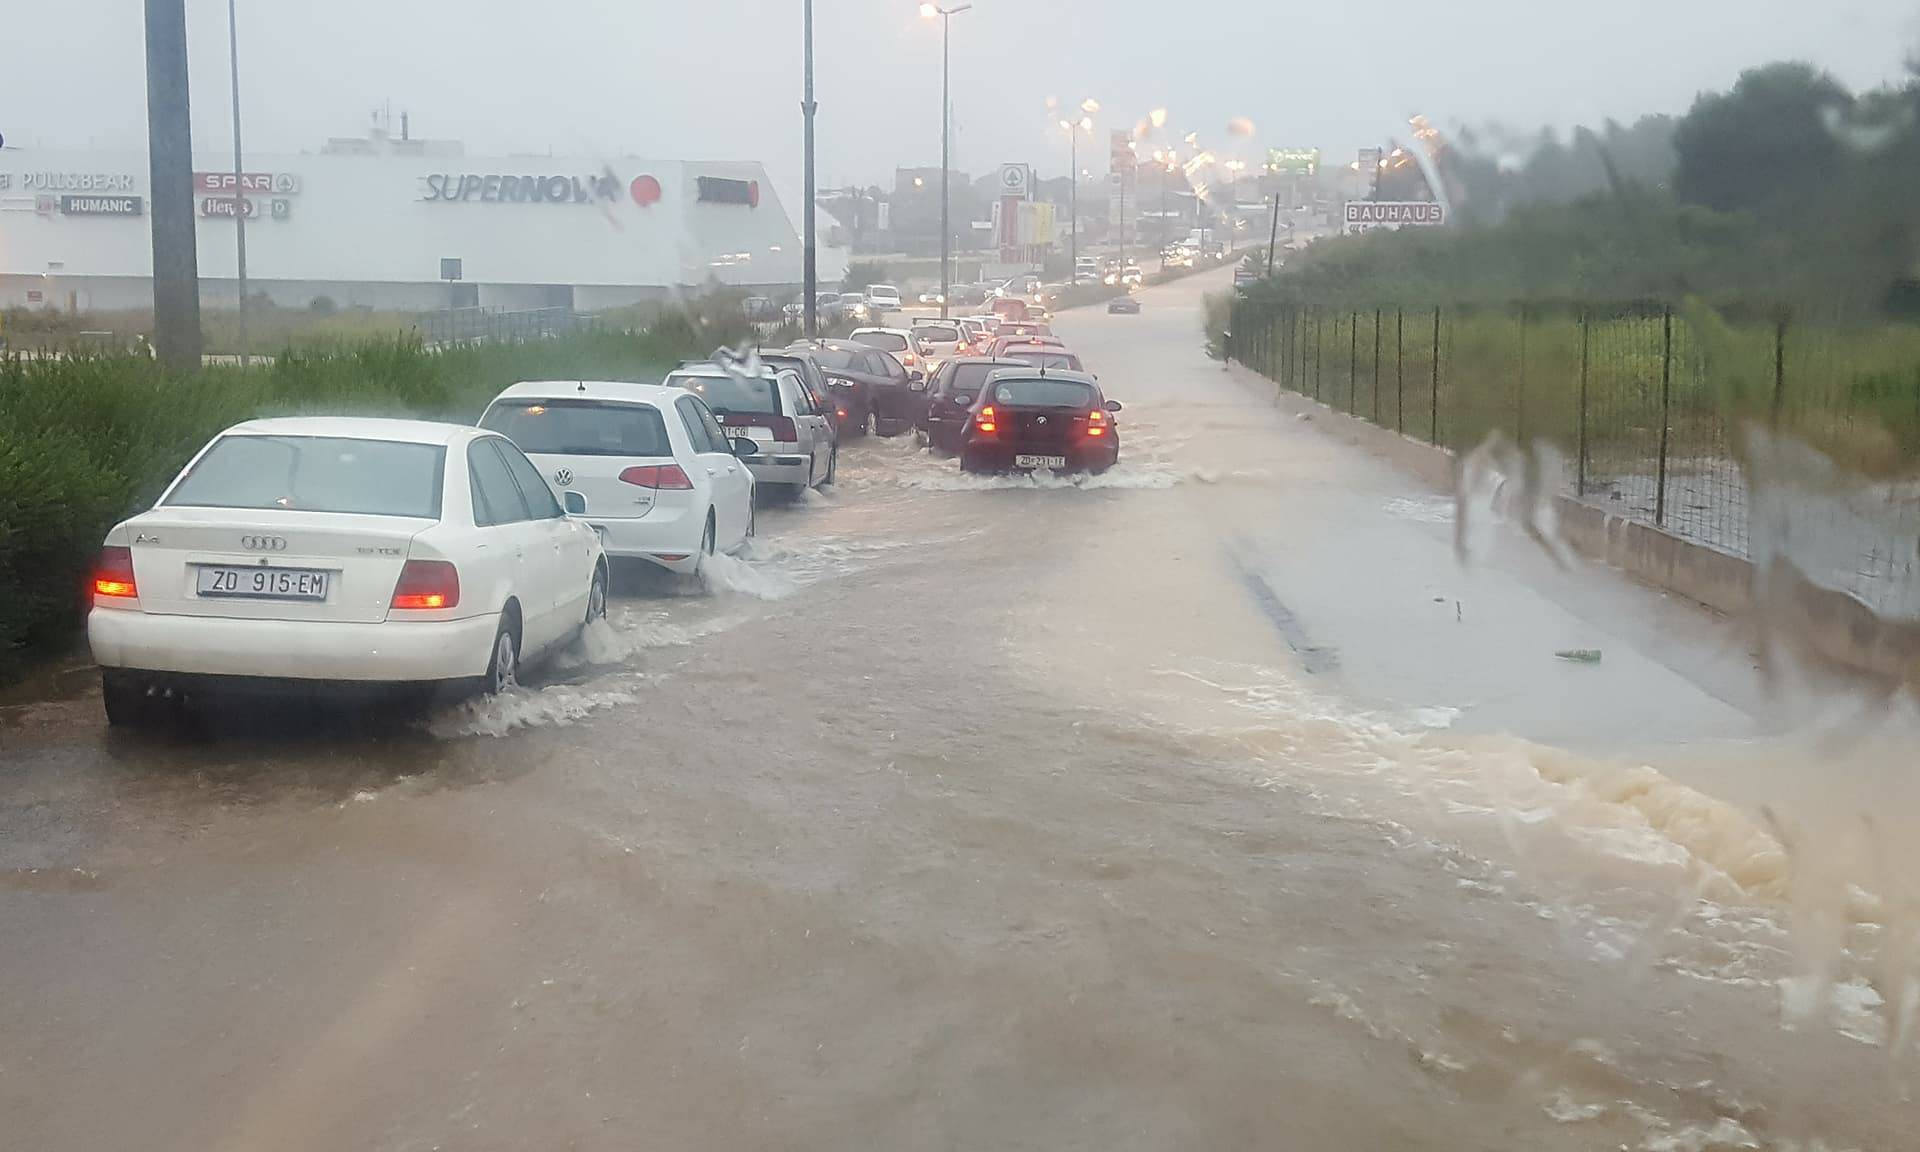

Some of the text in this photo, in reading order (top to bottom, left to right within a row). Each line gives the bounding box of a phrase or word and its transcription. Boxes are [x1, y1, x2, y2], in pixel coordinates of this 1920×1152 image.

[23, 173, 132, 190] PULL&BEAR
[206, 175, 270, 188] SPAR
[70, 199, 133, 212] HUMANIC
[1348, 206, 1440, 219] BAUHAUS
[212, 570, 324, 594] ZD 915-EM
